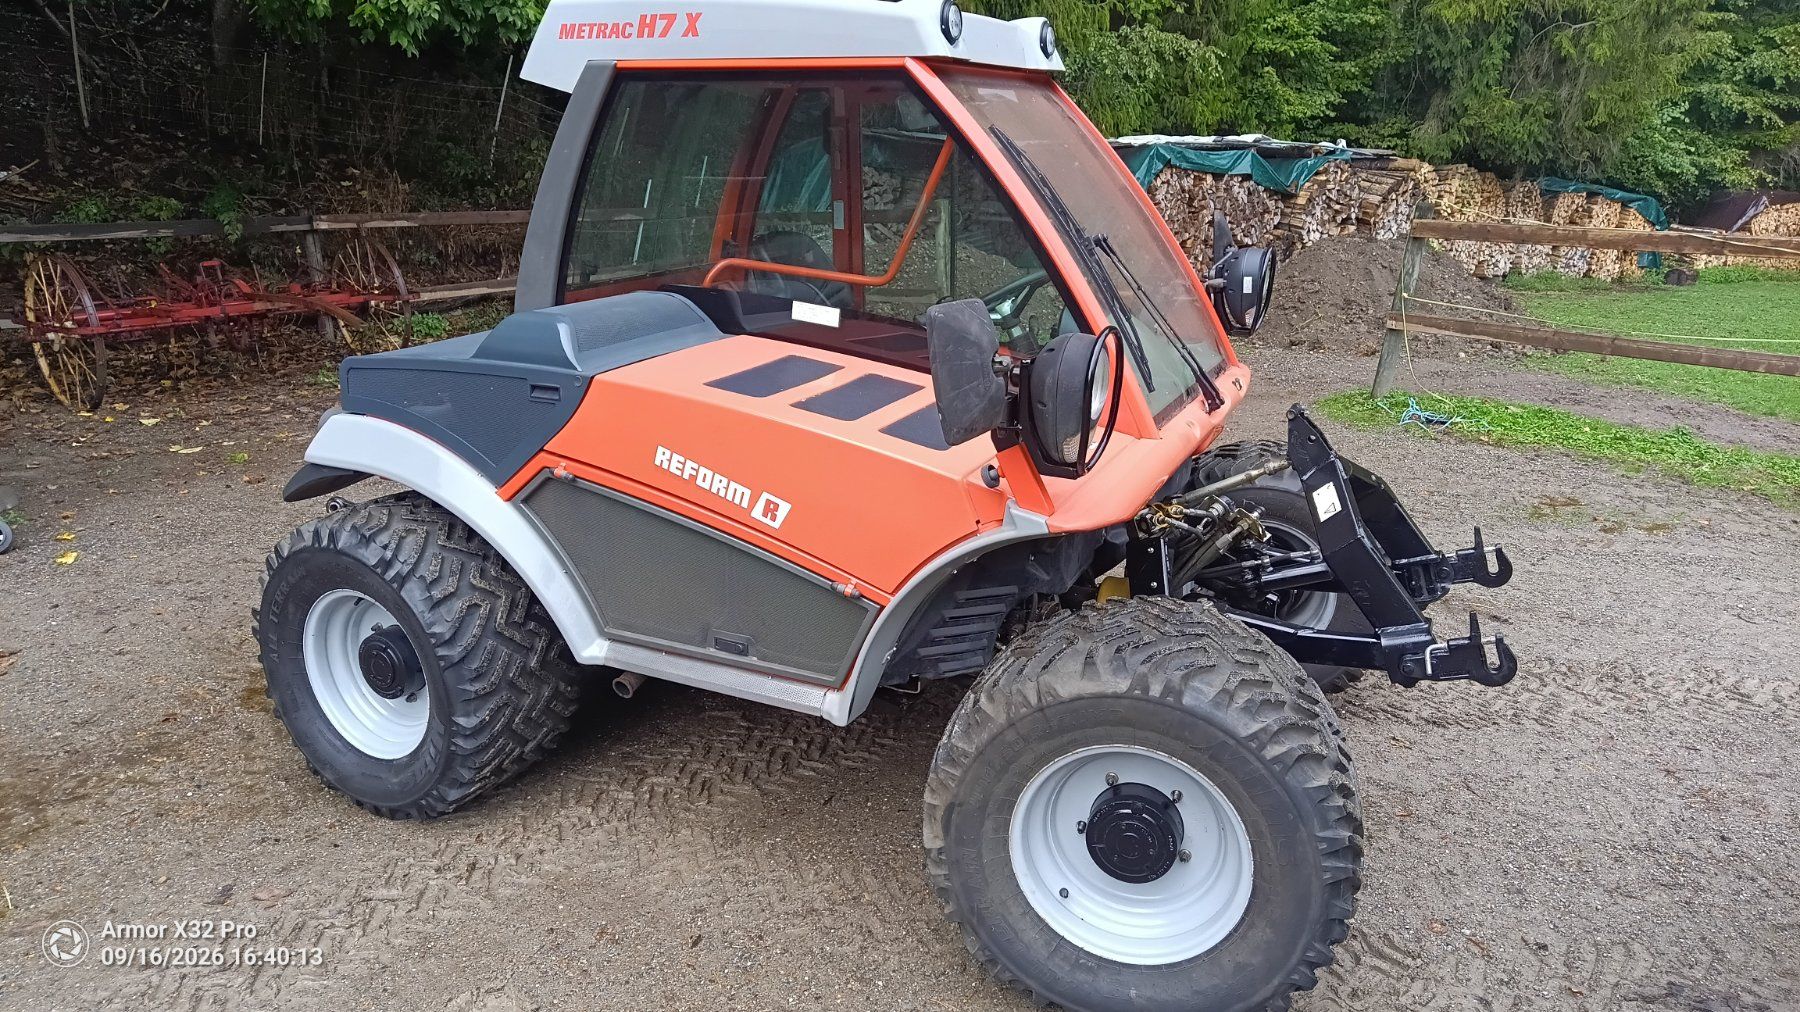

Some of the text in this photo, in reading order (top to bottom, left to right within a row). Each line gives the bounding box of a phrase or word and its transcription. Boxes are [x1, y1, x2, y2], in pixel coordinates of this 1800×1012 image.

[558, 12, 703, 40] METRAC H7 X
[654, 445, 752, 509] REFORM
